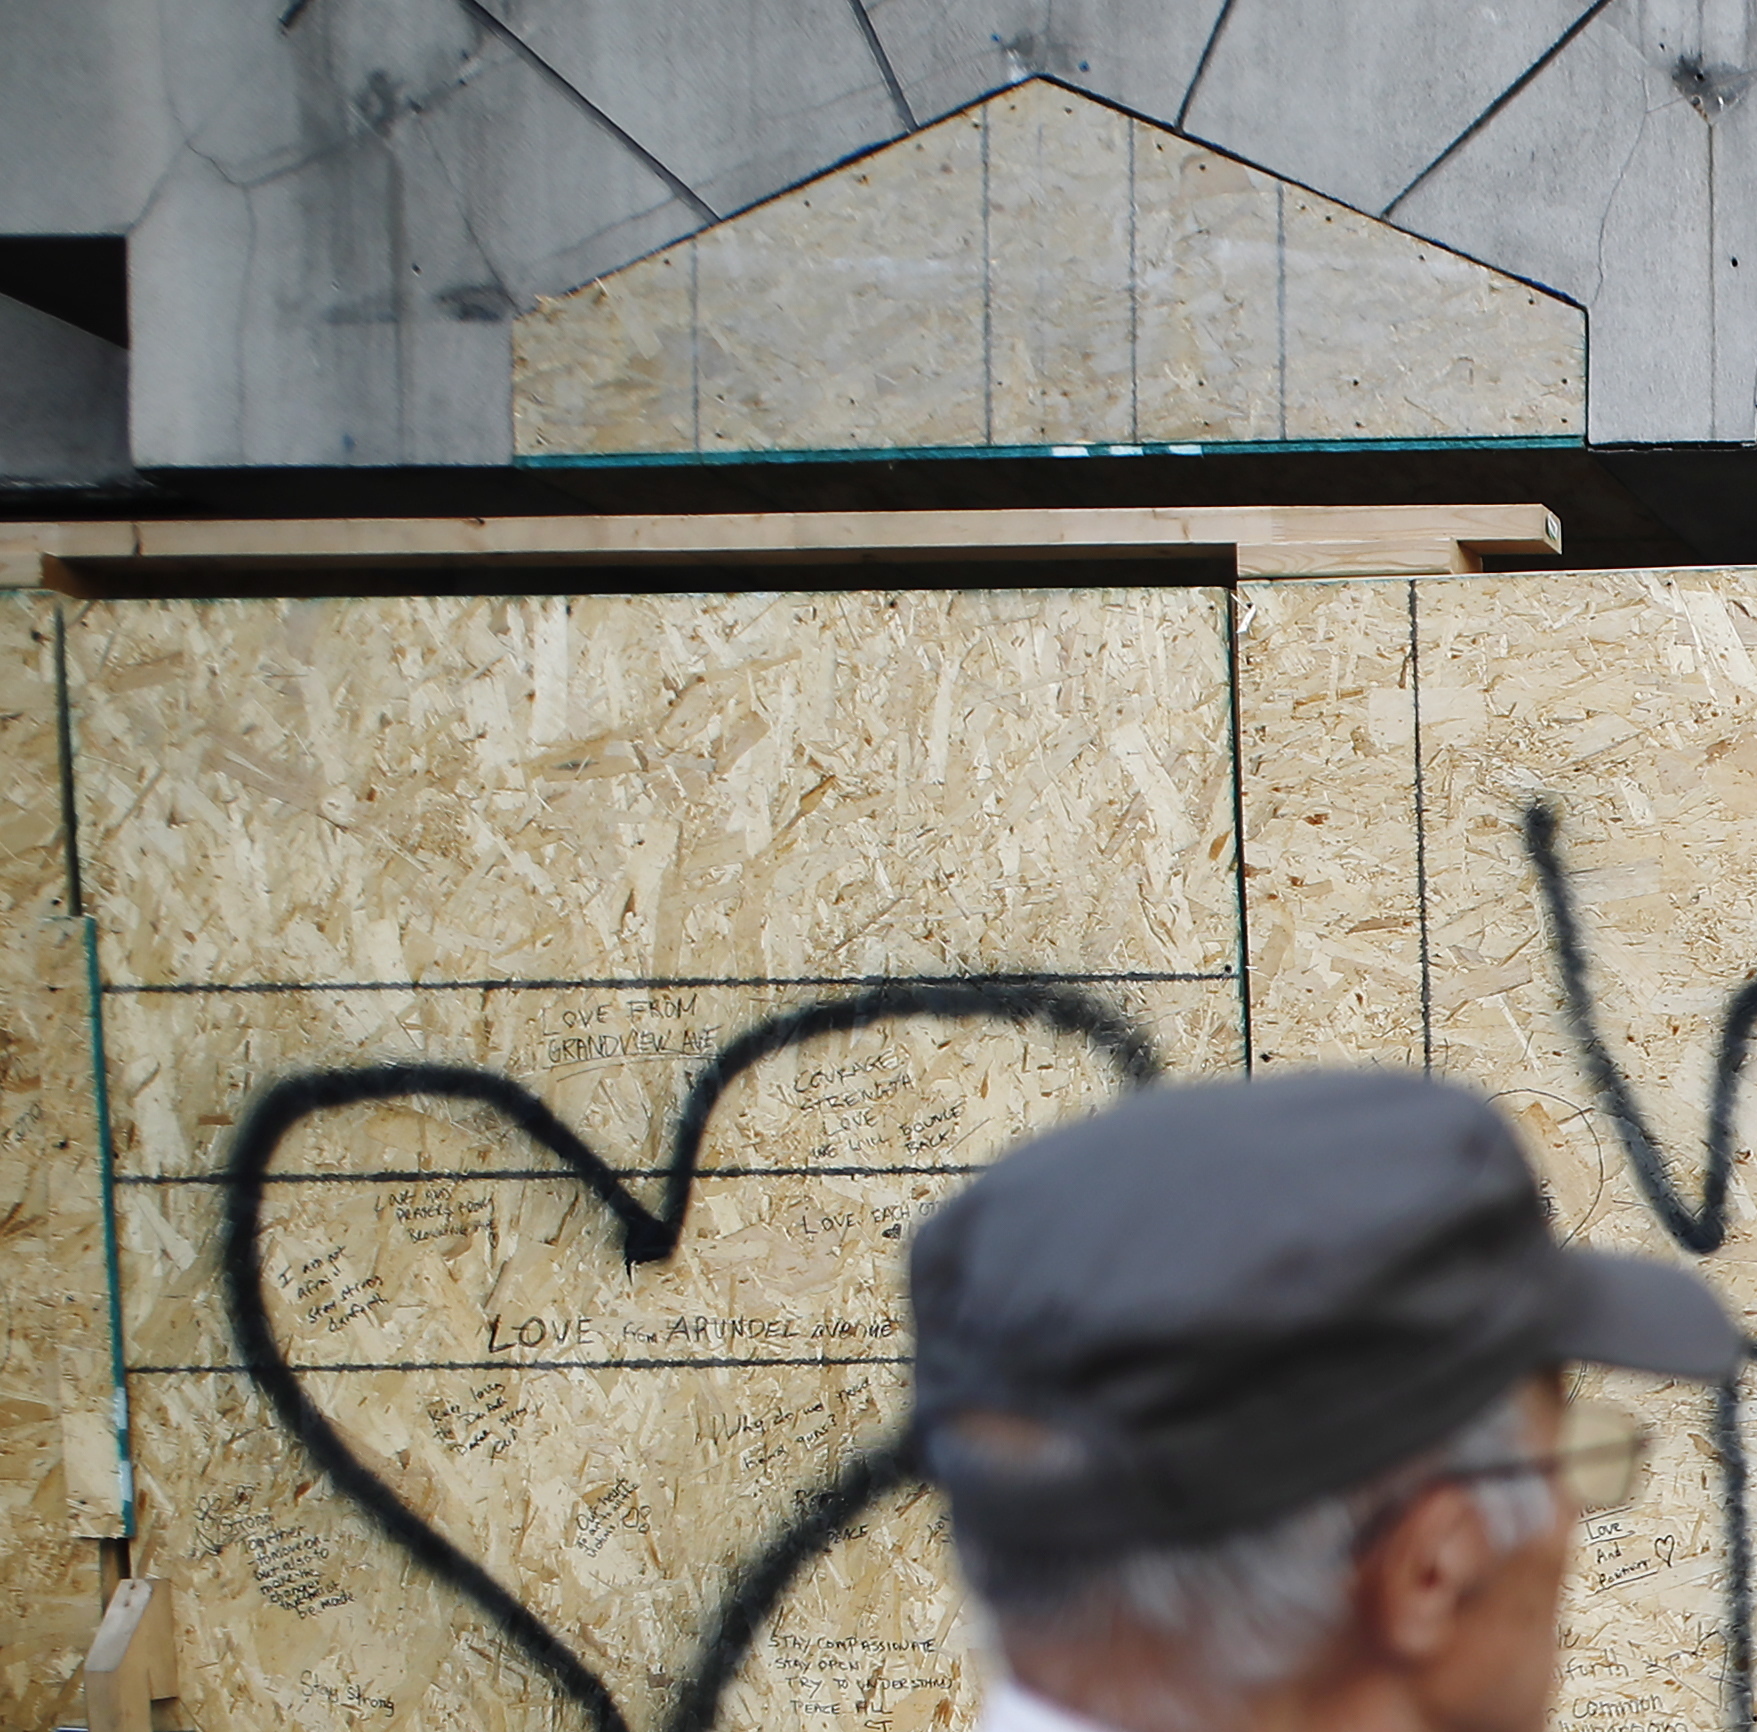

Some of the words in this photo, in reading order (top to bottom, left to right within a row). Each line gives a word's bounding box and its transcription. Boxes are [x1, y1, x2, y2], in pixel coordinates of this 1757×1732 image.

[542, 1003, 608, 1037] LOVE
[627, 994, 697, 1021] FROM
[803, 1213, 857, 1234] LOVE
[871, 1206, 911, 1223] EACH
[488, 1314, 594, 1353] LOVE
[666, 1315, 800, 1345] ARUNDEL
[768, 1636, 813, 1656] STAY
[817, 1636, 937, 1653] COMPASSIONATE
[786, 1677, 823, 1698] TRY
[790, 1700, 841, 1716] PEACE
